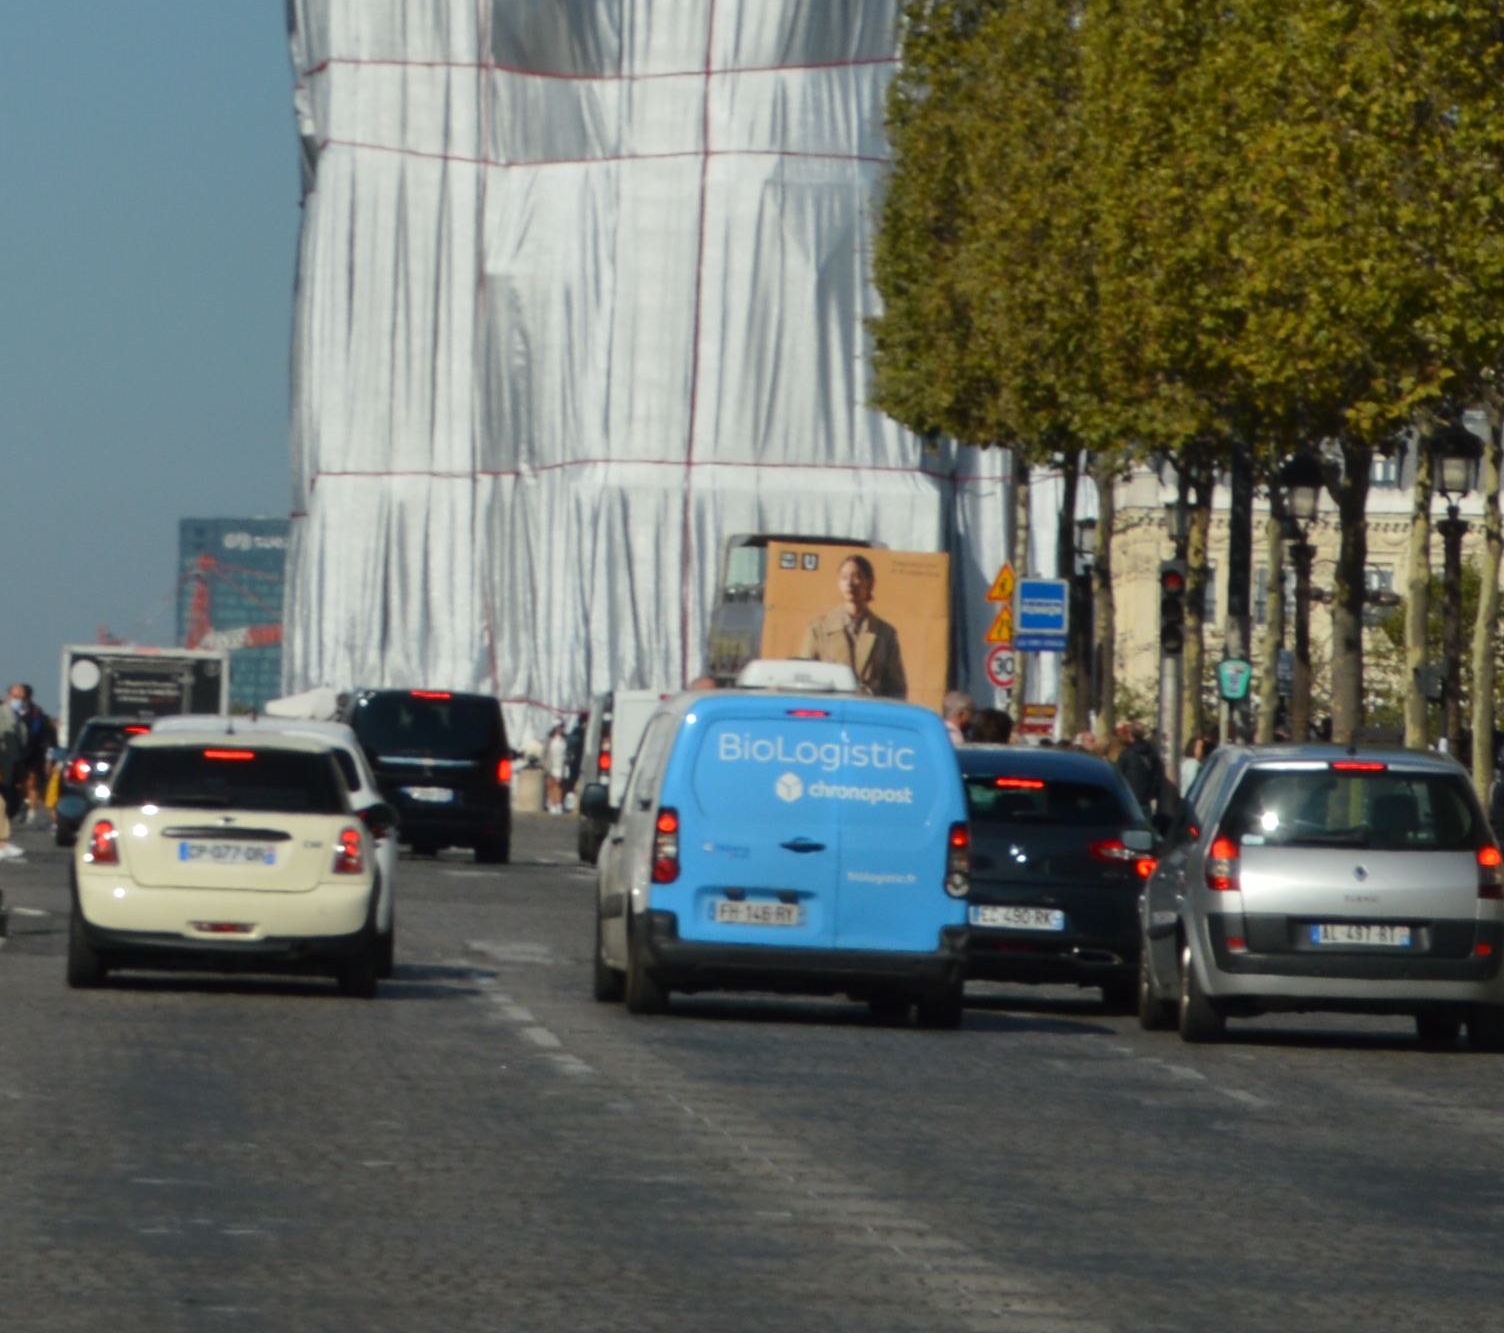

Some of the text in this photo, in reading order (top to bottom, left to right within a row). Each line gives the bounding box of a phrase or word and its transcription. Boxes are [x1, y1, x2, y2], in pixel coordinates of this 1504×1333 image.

[995, 656, 1015, 676] 30
[719, 733, 914, 771] BioLogistic
[809, 781, 912, 804] chronopost
